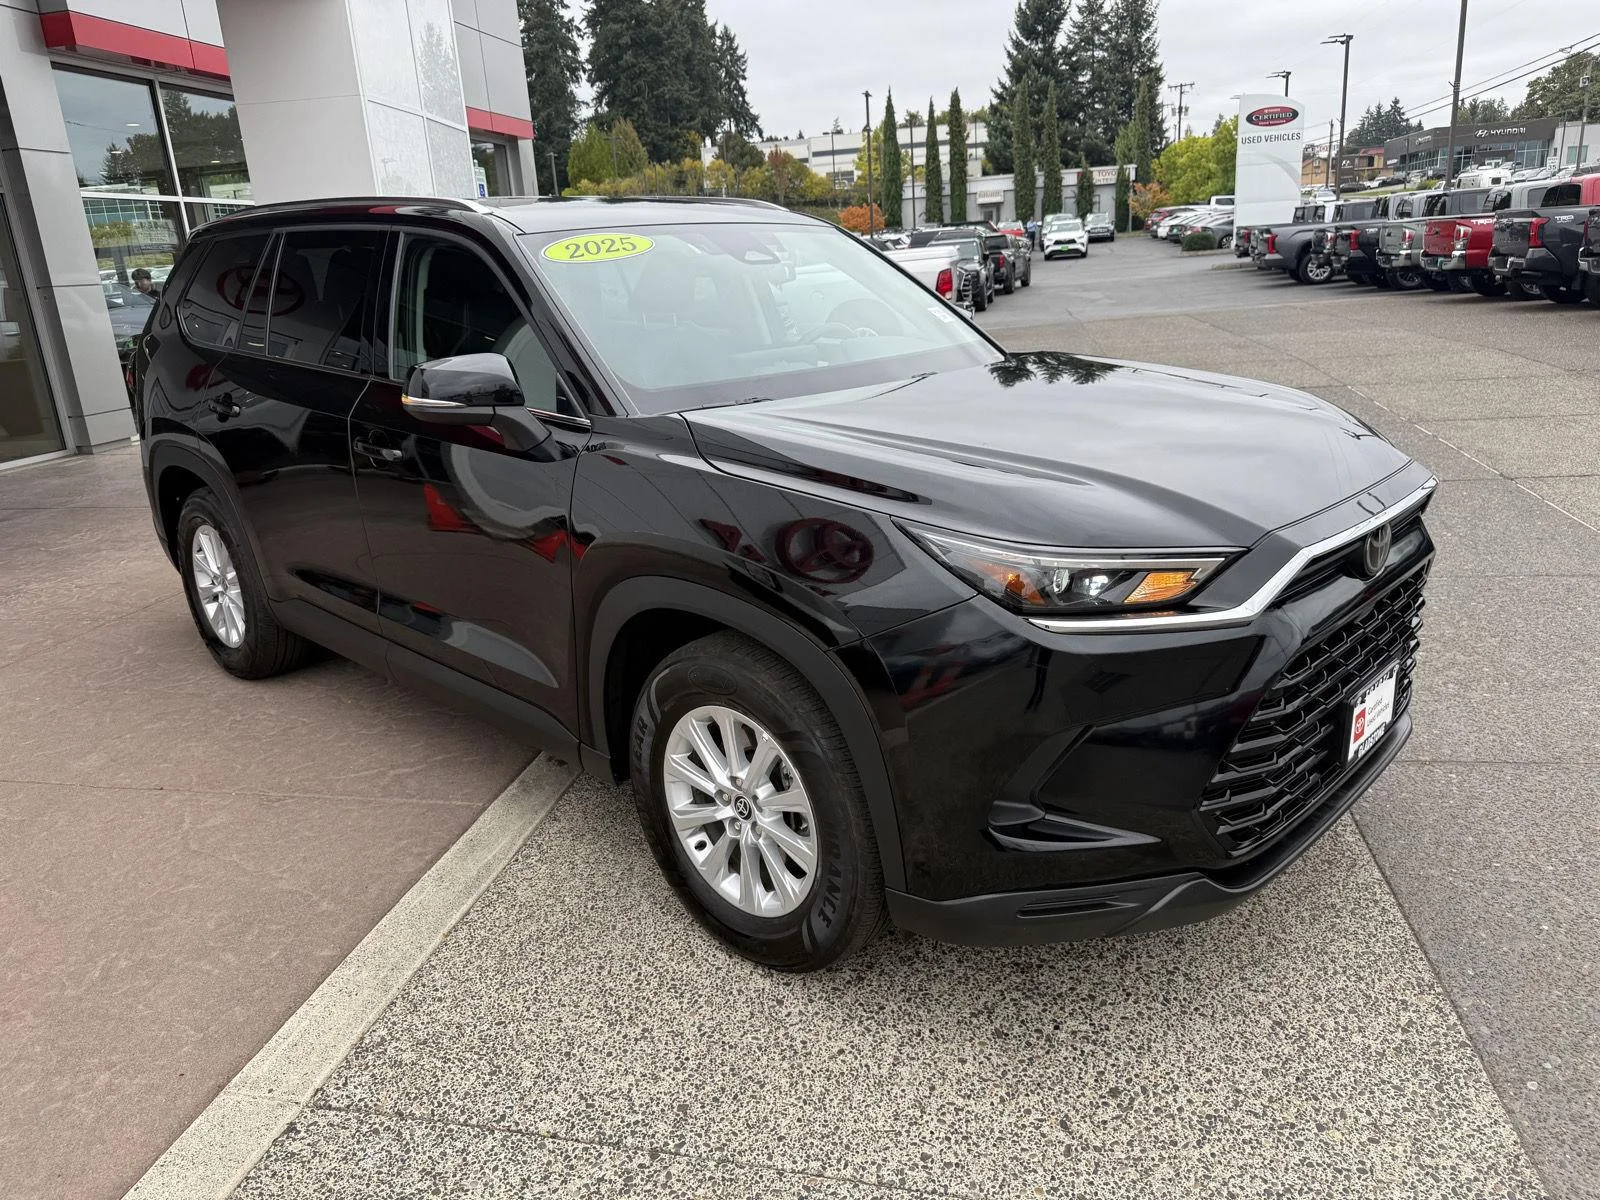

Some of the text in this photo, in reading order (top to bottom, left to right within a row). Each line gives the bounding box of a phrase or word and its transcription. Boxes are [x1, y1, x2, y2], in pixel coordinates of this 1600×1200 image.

[1252, 112, 1293, 121] CERTIFIED
[1490, 127, 1526, 136] HYUNDAI
[1241, 132, 1301, 145] USED VEHICLES
[565, 237, 637, 259] 2025
